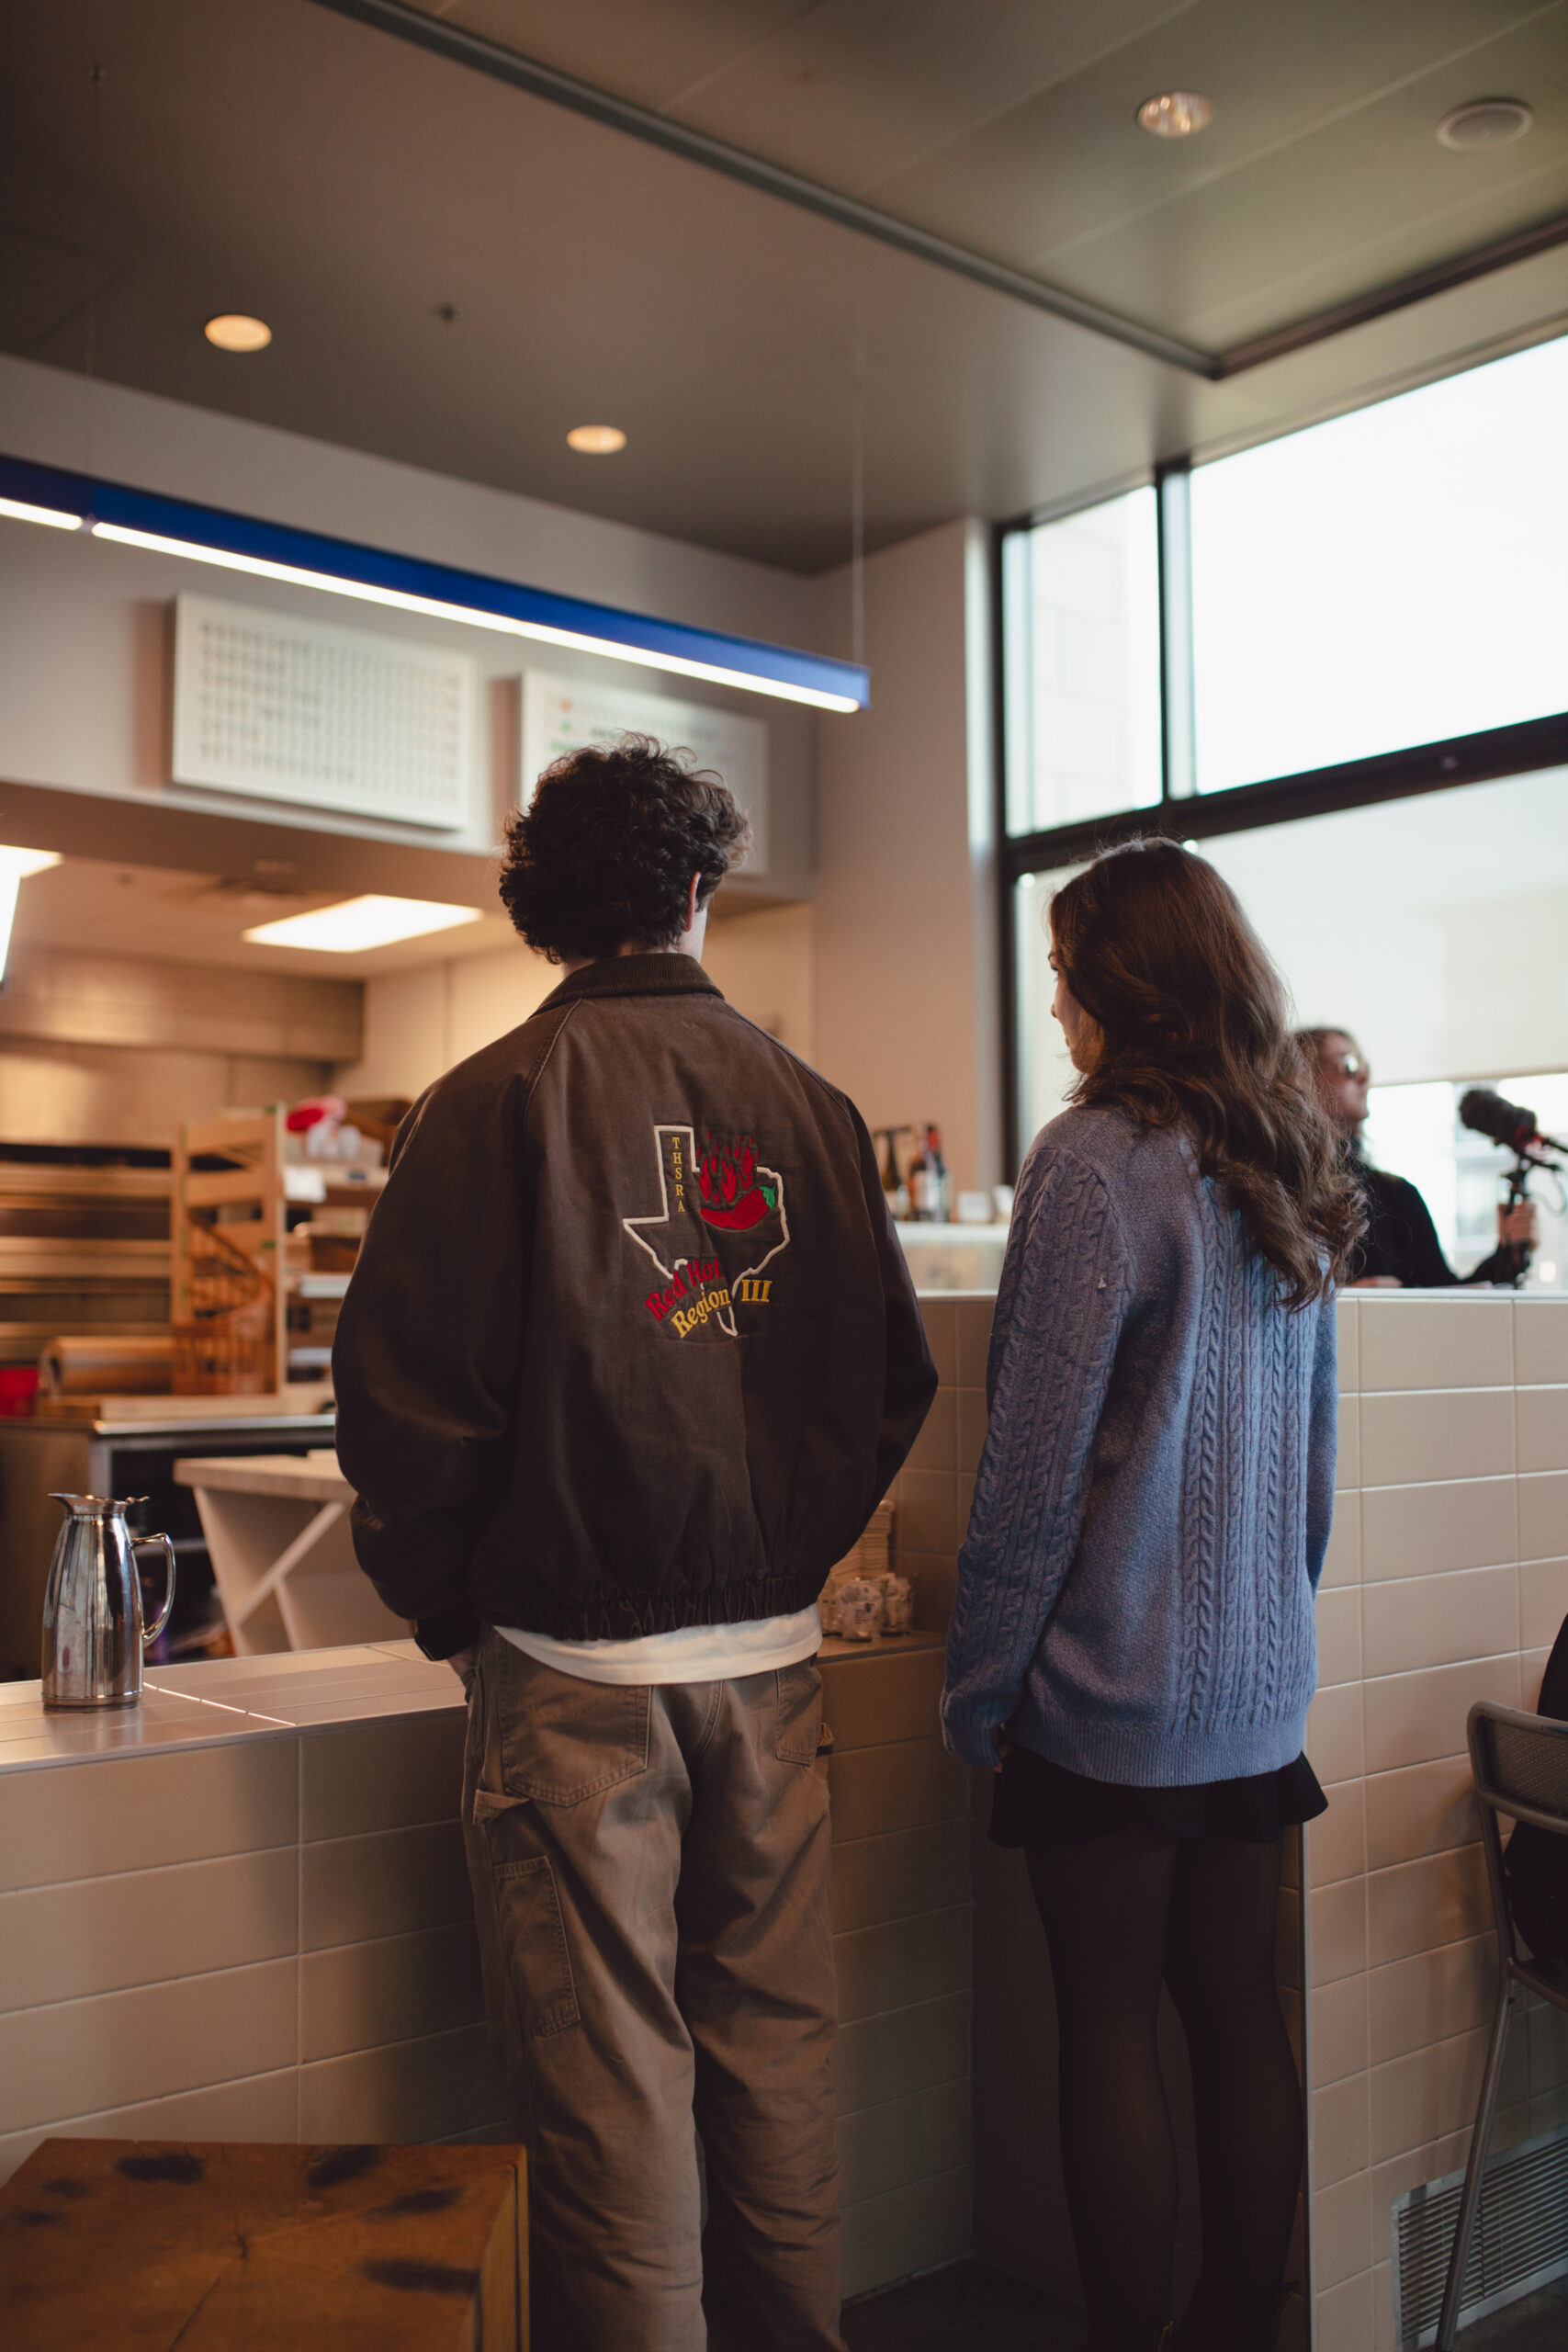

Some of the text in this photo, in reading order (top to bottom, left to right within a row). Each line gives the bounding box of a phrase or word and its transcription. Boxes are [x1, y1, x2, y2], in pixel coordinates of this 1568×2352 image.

[672, 1136, 686, 1213] THSRA
[644, 1258, 723, 1322] Red Hot
[671, 1279, 773, 1339] Region III
